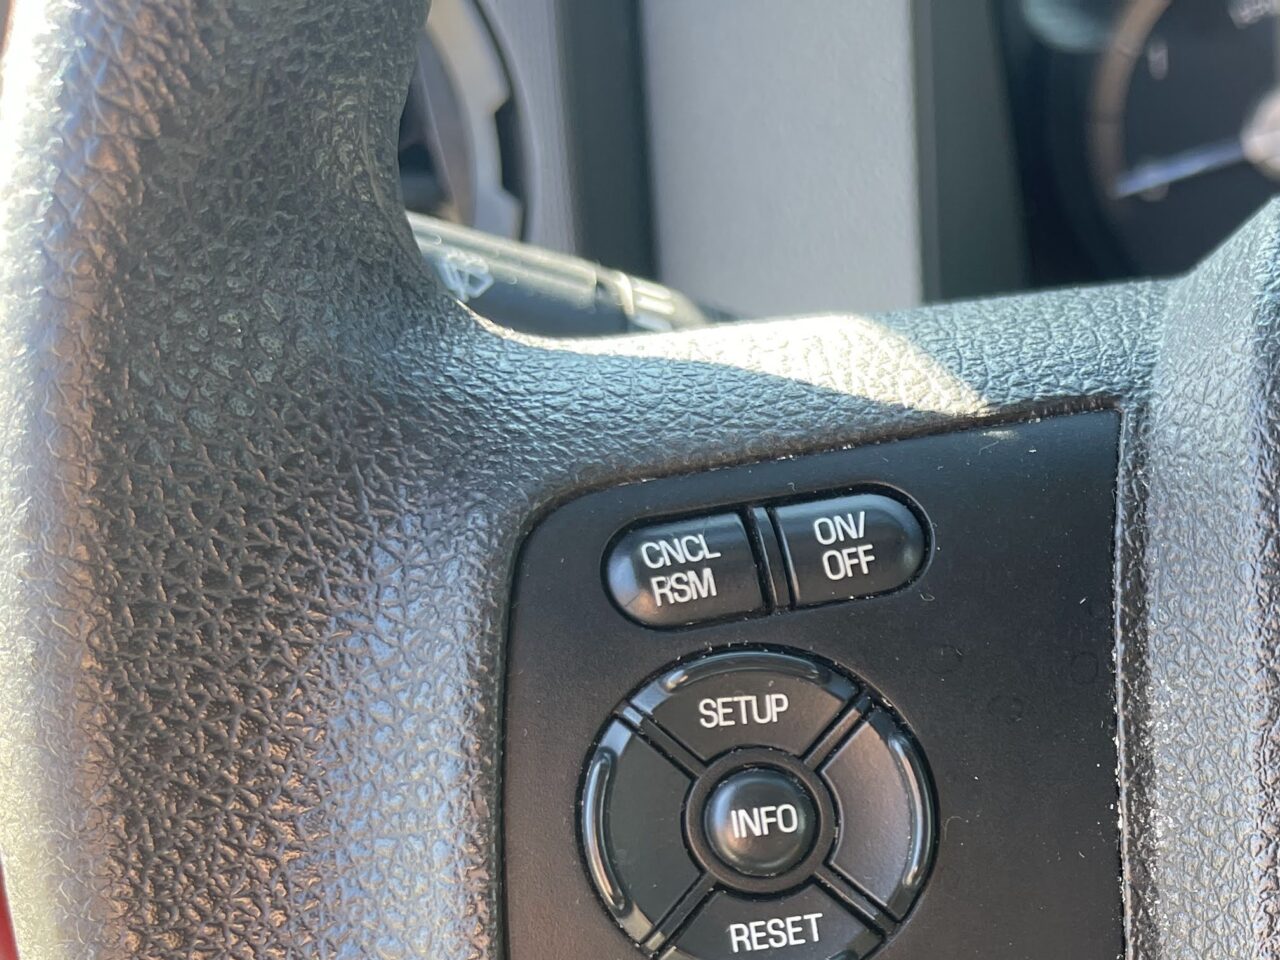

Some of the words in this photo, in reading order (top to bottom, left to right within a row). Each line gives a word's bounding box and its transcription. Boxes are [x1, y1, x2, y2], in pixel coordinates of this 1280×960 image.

[813, 510, 866, 547] ON/
[640, 533, 721, 570] CNCL
[821, 543, 876, 581] OFF
[650, 567, 718, 607] RSM
[699, 693, 789, 729] SETUP
[730, 803, 798, 839] INFO
[728, 912, 823, 953] RESET
